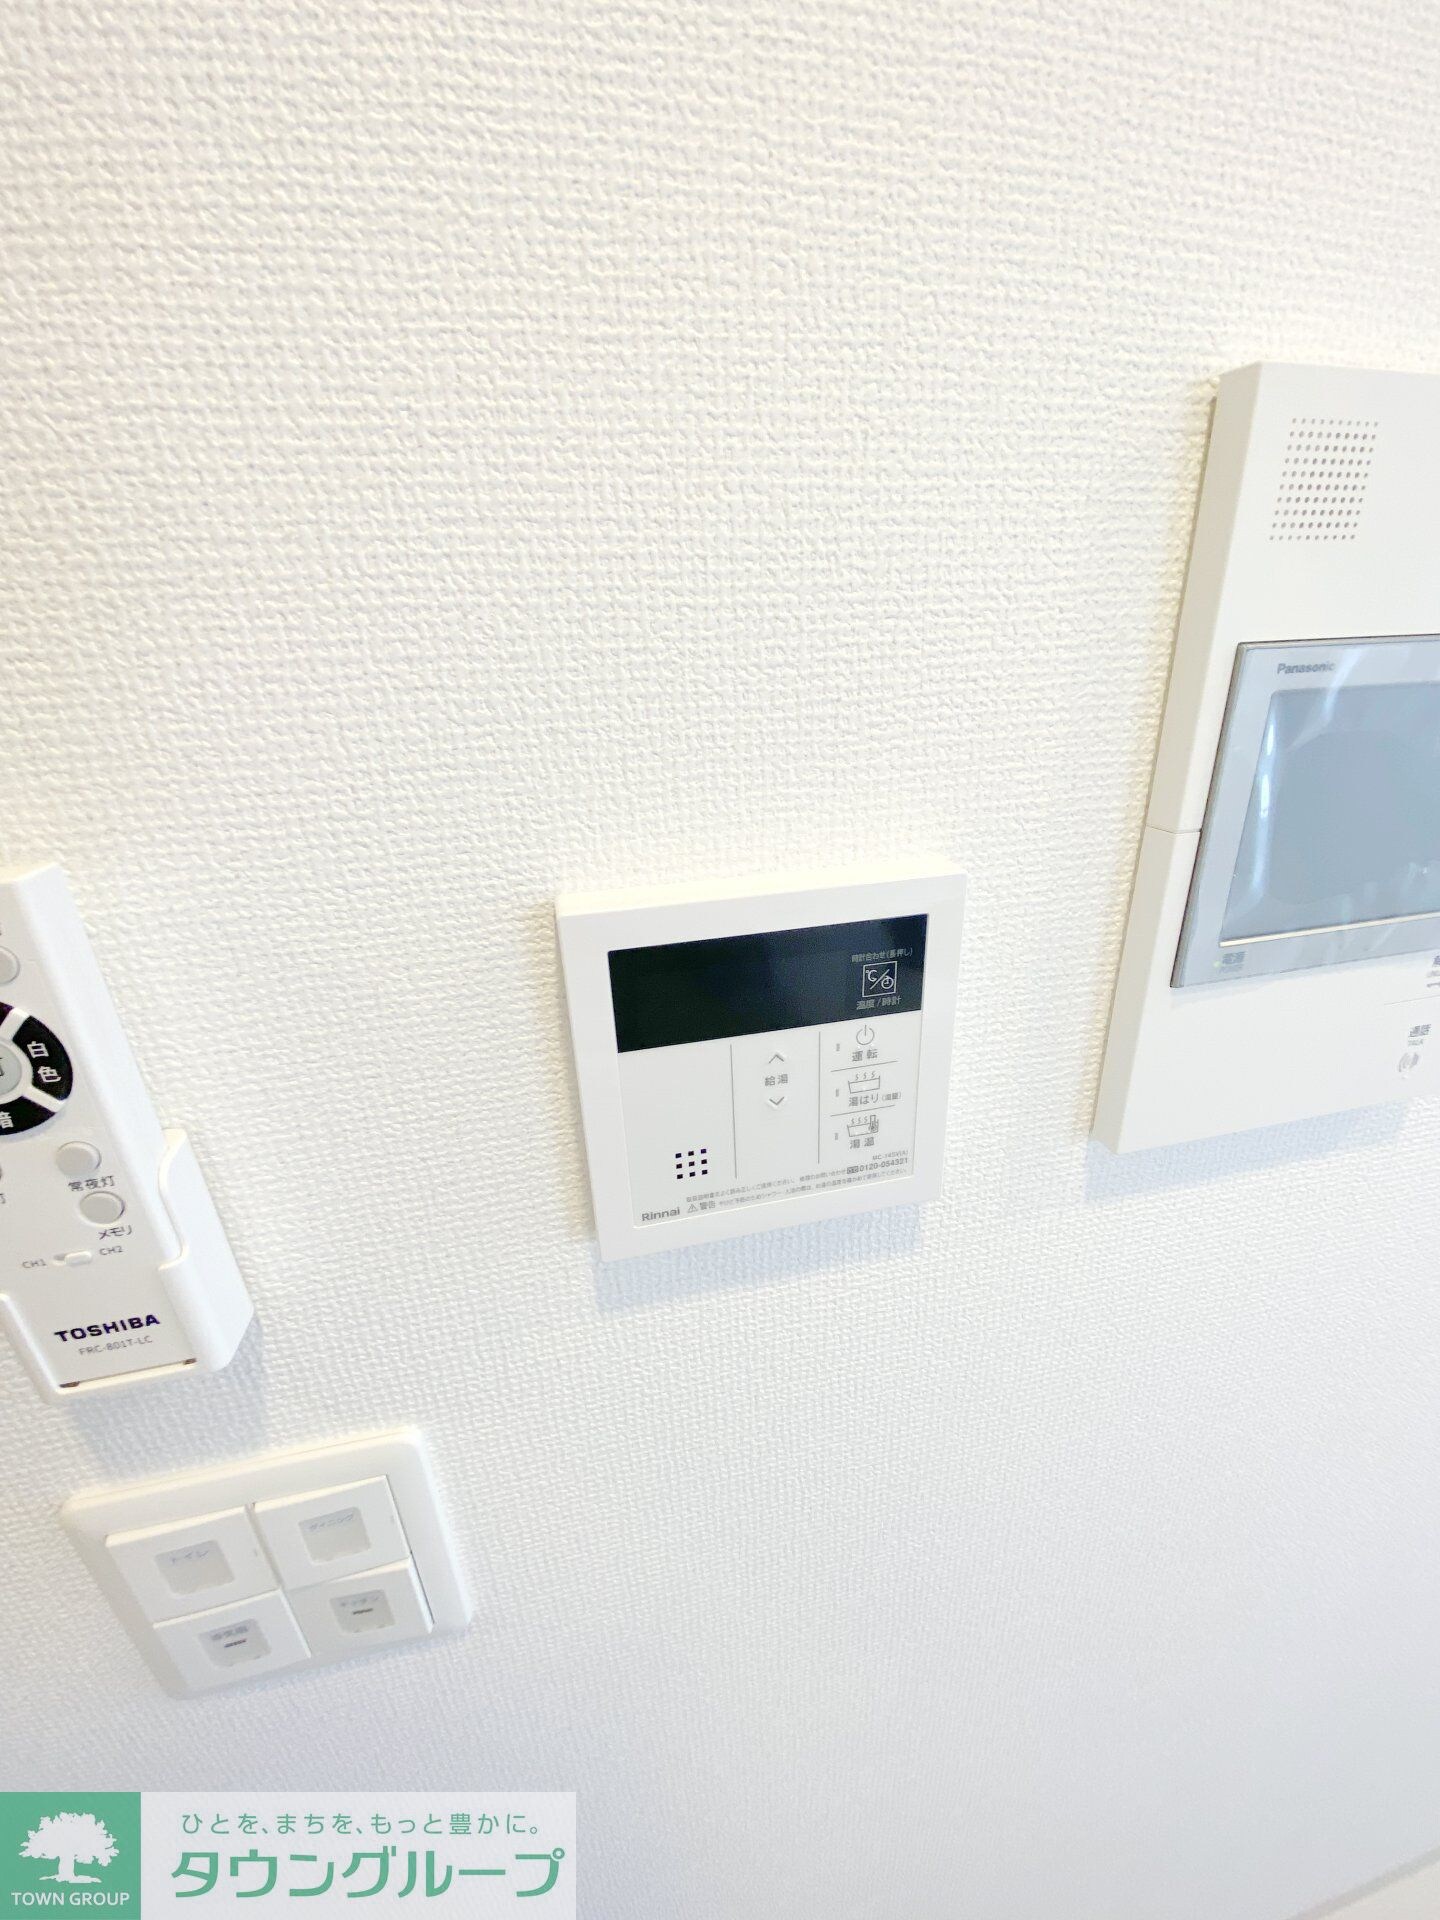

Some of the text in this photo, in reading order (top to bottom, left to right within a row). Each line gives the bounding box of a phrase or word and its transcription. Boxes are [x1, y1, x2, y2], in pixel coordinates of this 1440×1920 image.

[1277, 662, 1336, 675] Panasonic
[852, 1049, 878, 1062] 運転
[764, 1073, 788, 1086] 給湯
[849, 1093, 879, 1107] 湯はり
[849, 1136, 875, 1149] 湯温
[859, 1157, 909, 1172] 0120-054321
[68, 1175, 115, 1191] 常夜灯
[641, 1206, 680, 1221] Rinnai
[98, 1225, 132, 1240] メモリ
[99, 1245, 123, 1256] CH2
[22, 1258, 47, 1269] CH1
[54, 1314, 160, 1342] TOSHIBA
